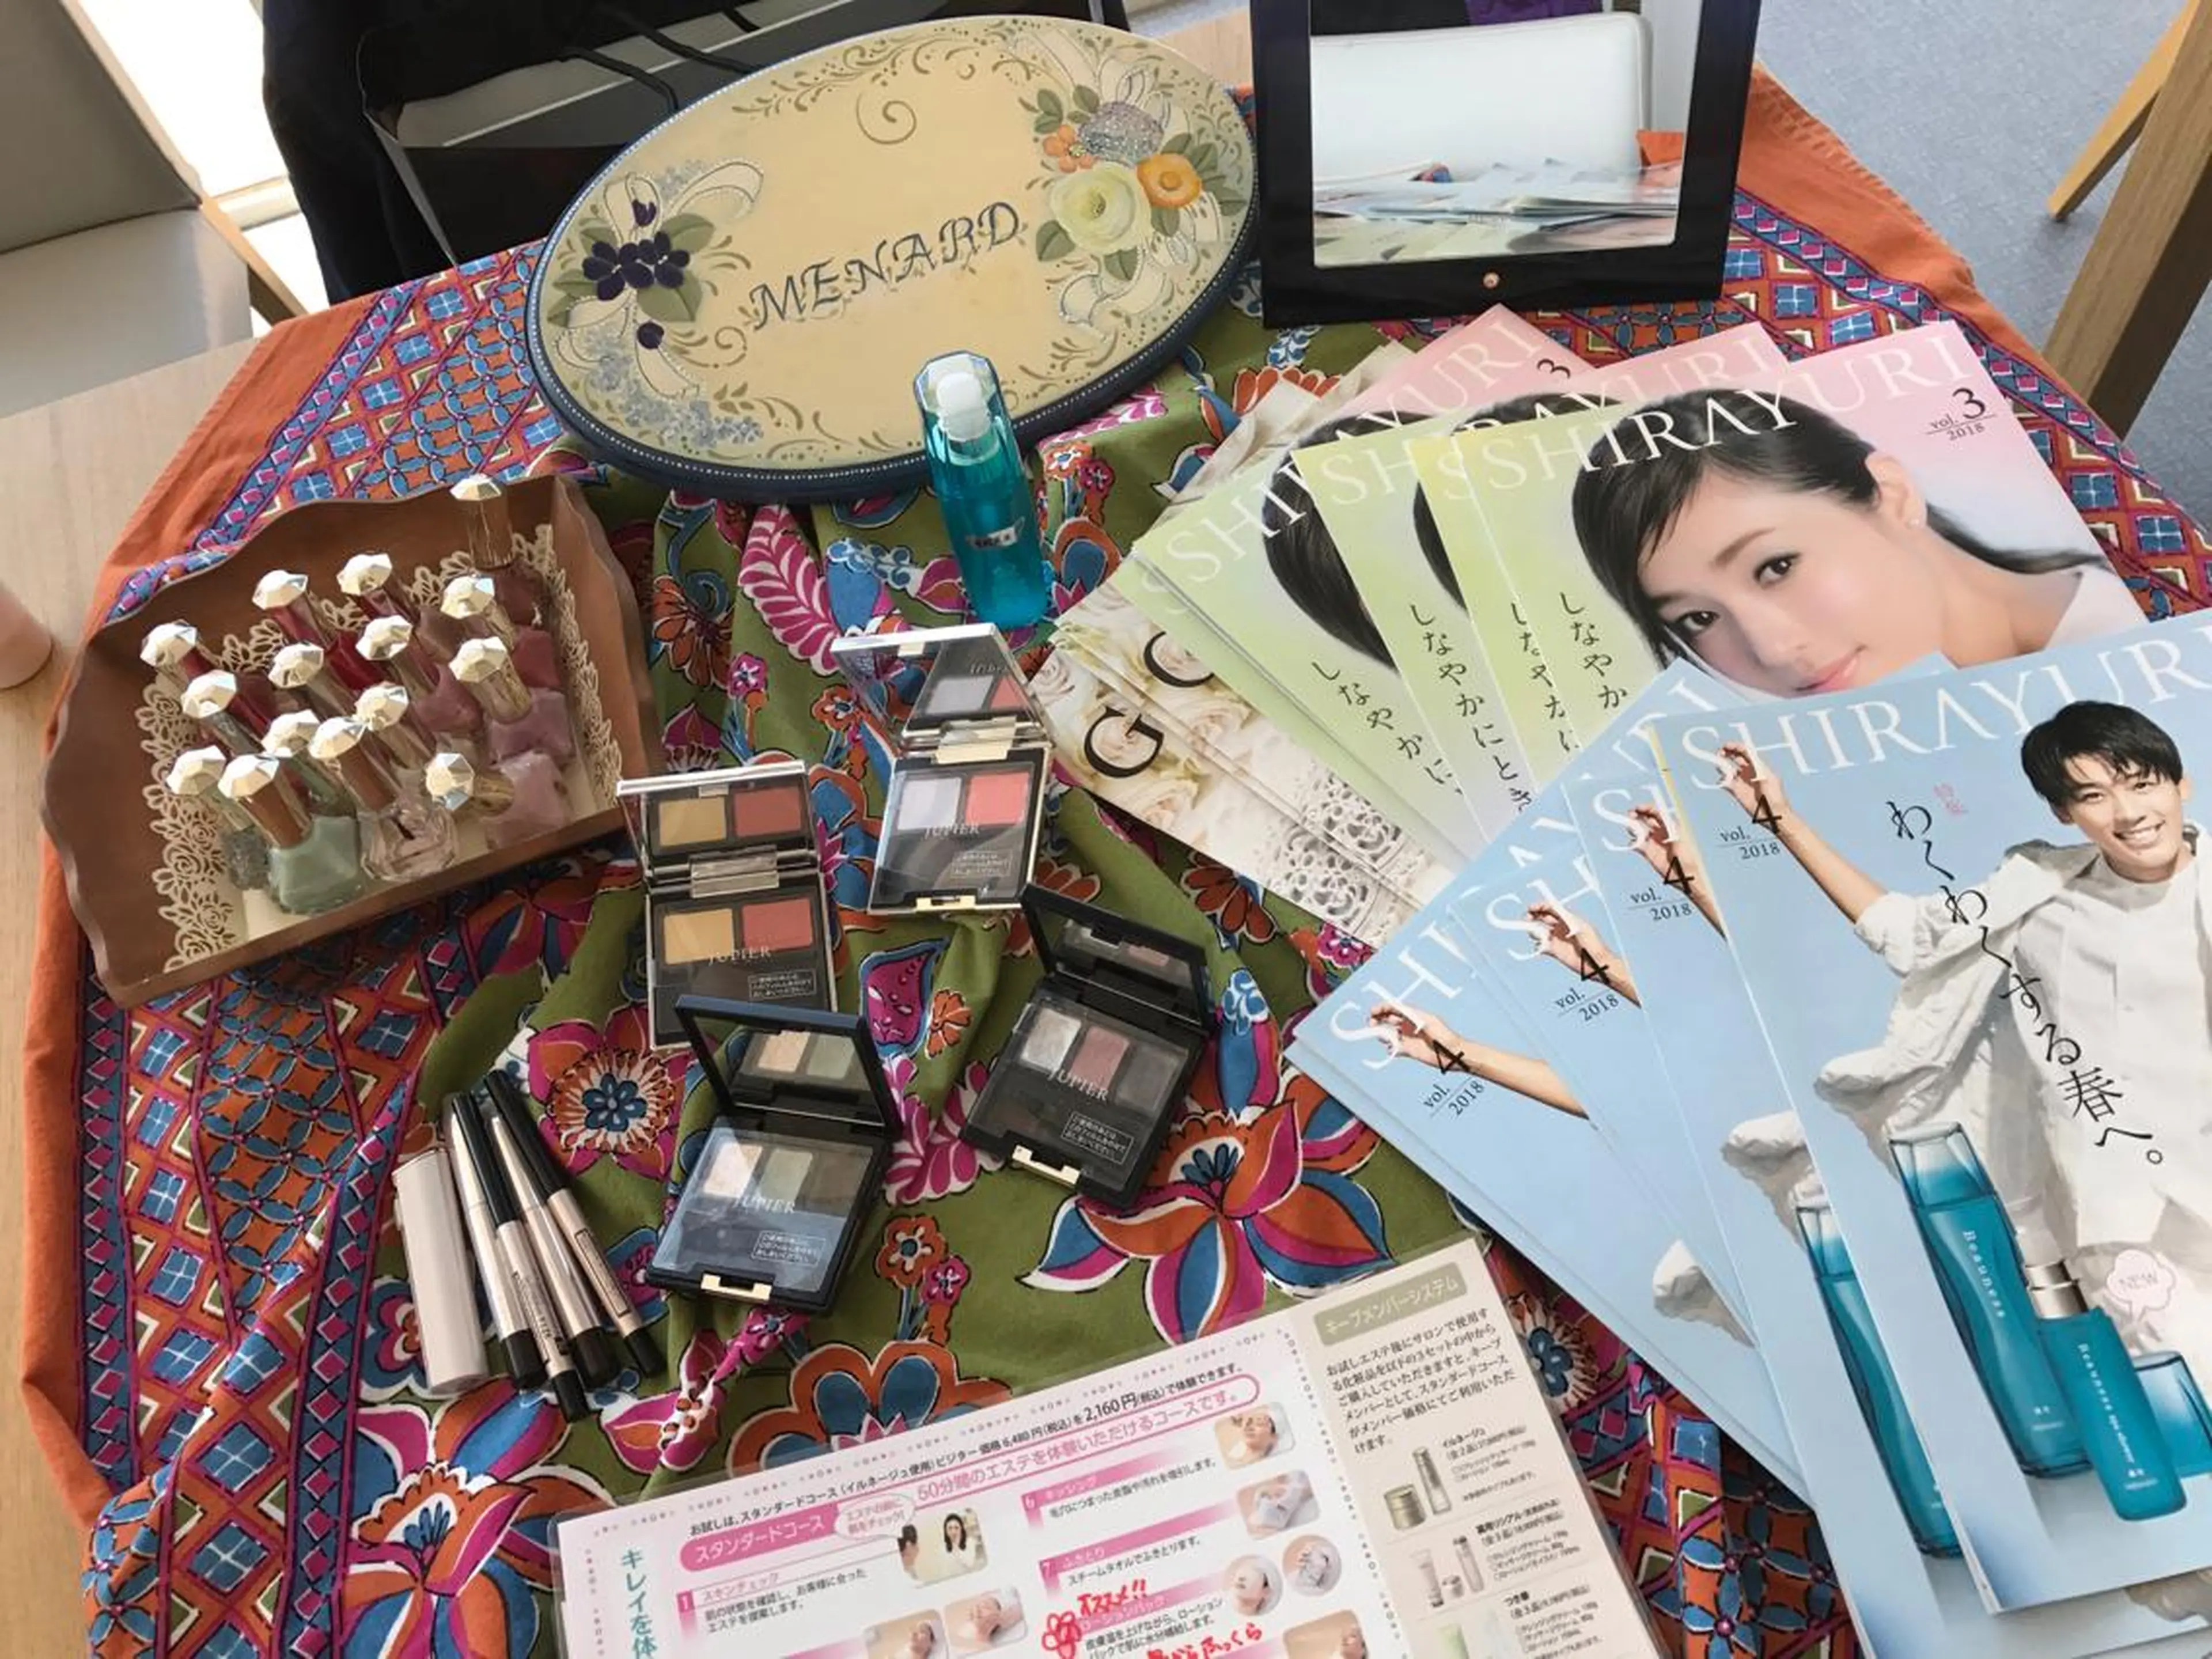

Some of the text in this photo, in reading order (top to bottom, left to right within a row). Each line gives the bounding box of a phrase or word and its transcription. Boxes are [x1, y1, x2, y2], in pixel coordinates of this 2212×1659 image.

[749, 202, 1020, 331] MENARD
[1487, 337, 1976, 490] SHIRAYURI
[1930, 388, 1985, 429] vol. 3
[1946, 422, 1985, 441] 2018
[1719, 794, 1782, 842] vol. 4
[1740, 841, 1781, 861] 2018
[1630, 856, 1694, 903] vol. 4
[1650, 903, 1693, 922] 2018
[1555, 948, 1609, 1010] vol. 4
[1885, 801, 2163, 1165] わくわくする春へ。
[1578, 994, 1620, 1022] 2018
[1423, 1040, 1471, 1109] vol. 4
[1448, 1080, 1486, 1116] 2018
[696, 1516, 825, 1564] スタンダードコース
